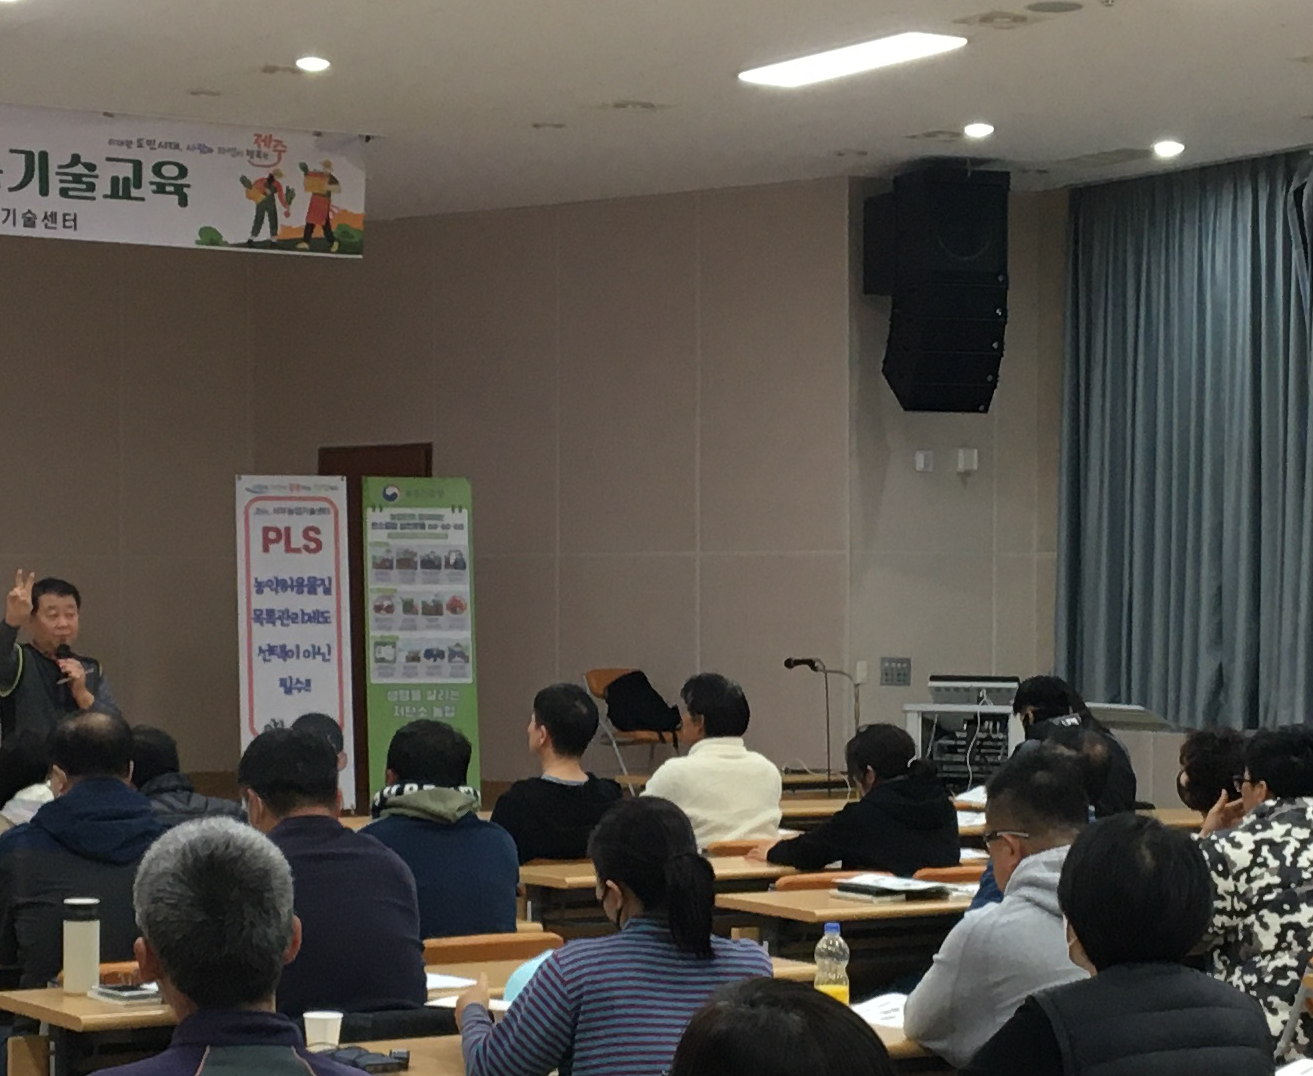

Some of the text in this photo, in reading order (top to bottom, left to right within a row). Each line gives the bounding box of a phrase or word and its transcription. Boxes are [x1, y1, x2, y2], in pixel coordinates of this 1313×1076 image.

[249, 133, 288, 168] 제주
[261, 525, 323, 555] PLS
[253, 575, 333, 596] 농약허용물질
[252, 608, 333, 627] 목록관리제도
[302, 643, 332, 663] 아닌
